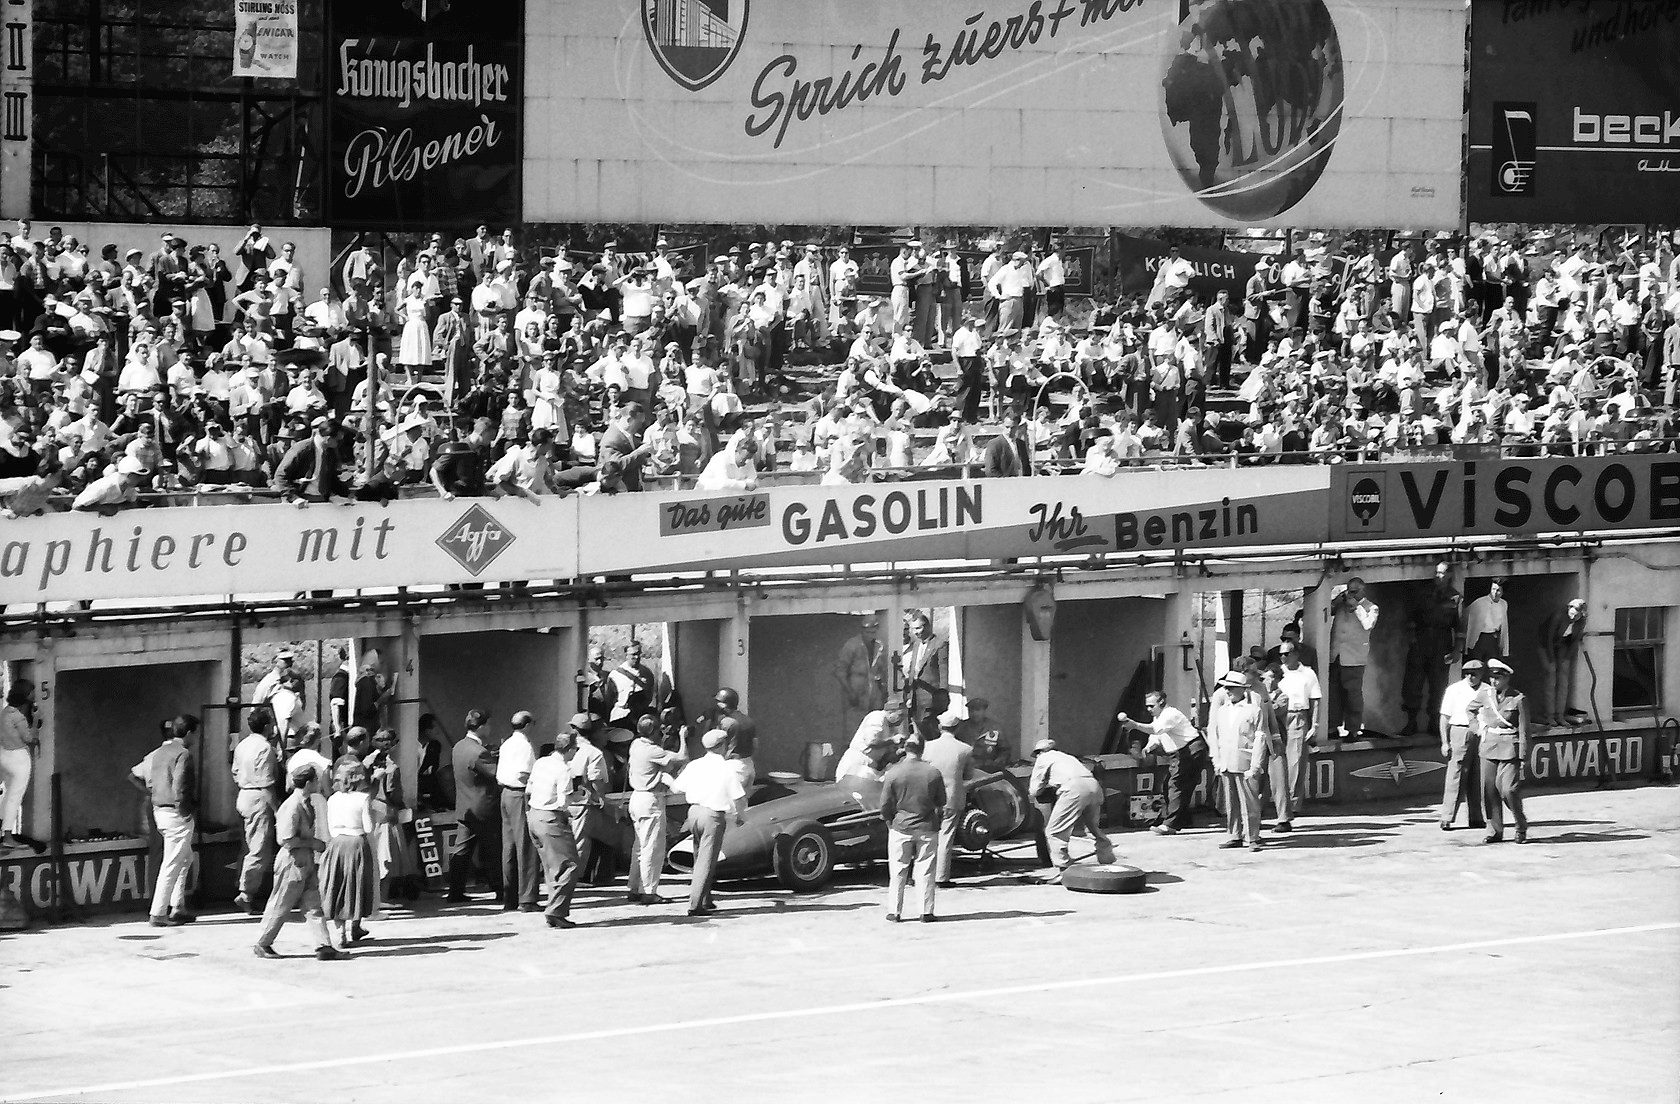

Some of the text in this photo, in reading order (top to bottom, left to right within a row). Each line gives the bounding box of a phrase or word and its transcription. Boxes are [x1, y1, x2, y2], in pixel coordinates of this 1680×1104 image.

[238, 2, 295, 14] STIRLING MOSS
[257, 27, 294, 37] ENICAR
[337, 38, 509, 108] Königsbacher
[745, 28, 906, 149] Sprich
[344, 113, 502, 198] Pilsener
[667, 502, 711, 530] Das
[782, 484, 982, 545] GASOLIN
[1029, 497, 1257, 550] Ihr Benzin
[0, 516, 395, 591] aphiere mit
[446, 521, 501, 562] Agfa
[405, 659, 414, 677] 4
[737, 638, 746, 656] 3
[41, 680, 50, 700] 5
[414, 817, 443, 877] BEHR
